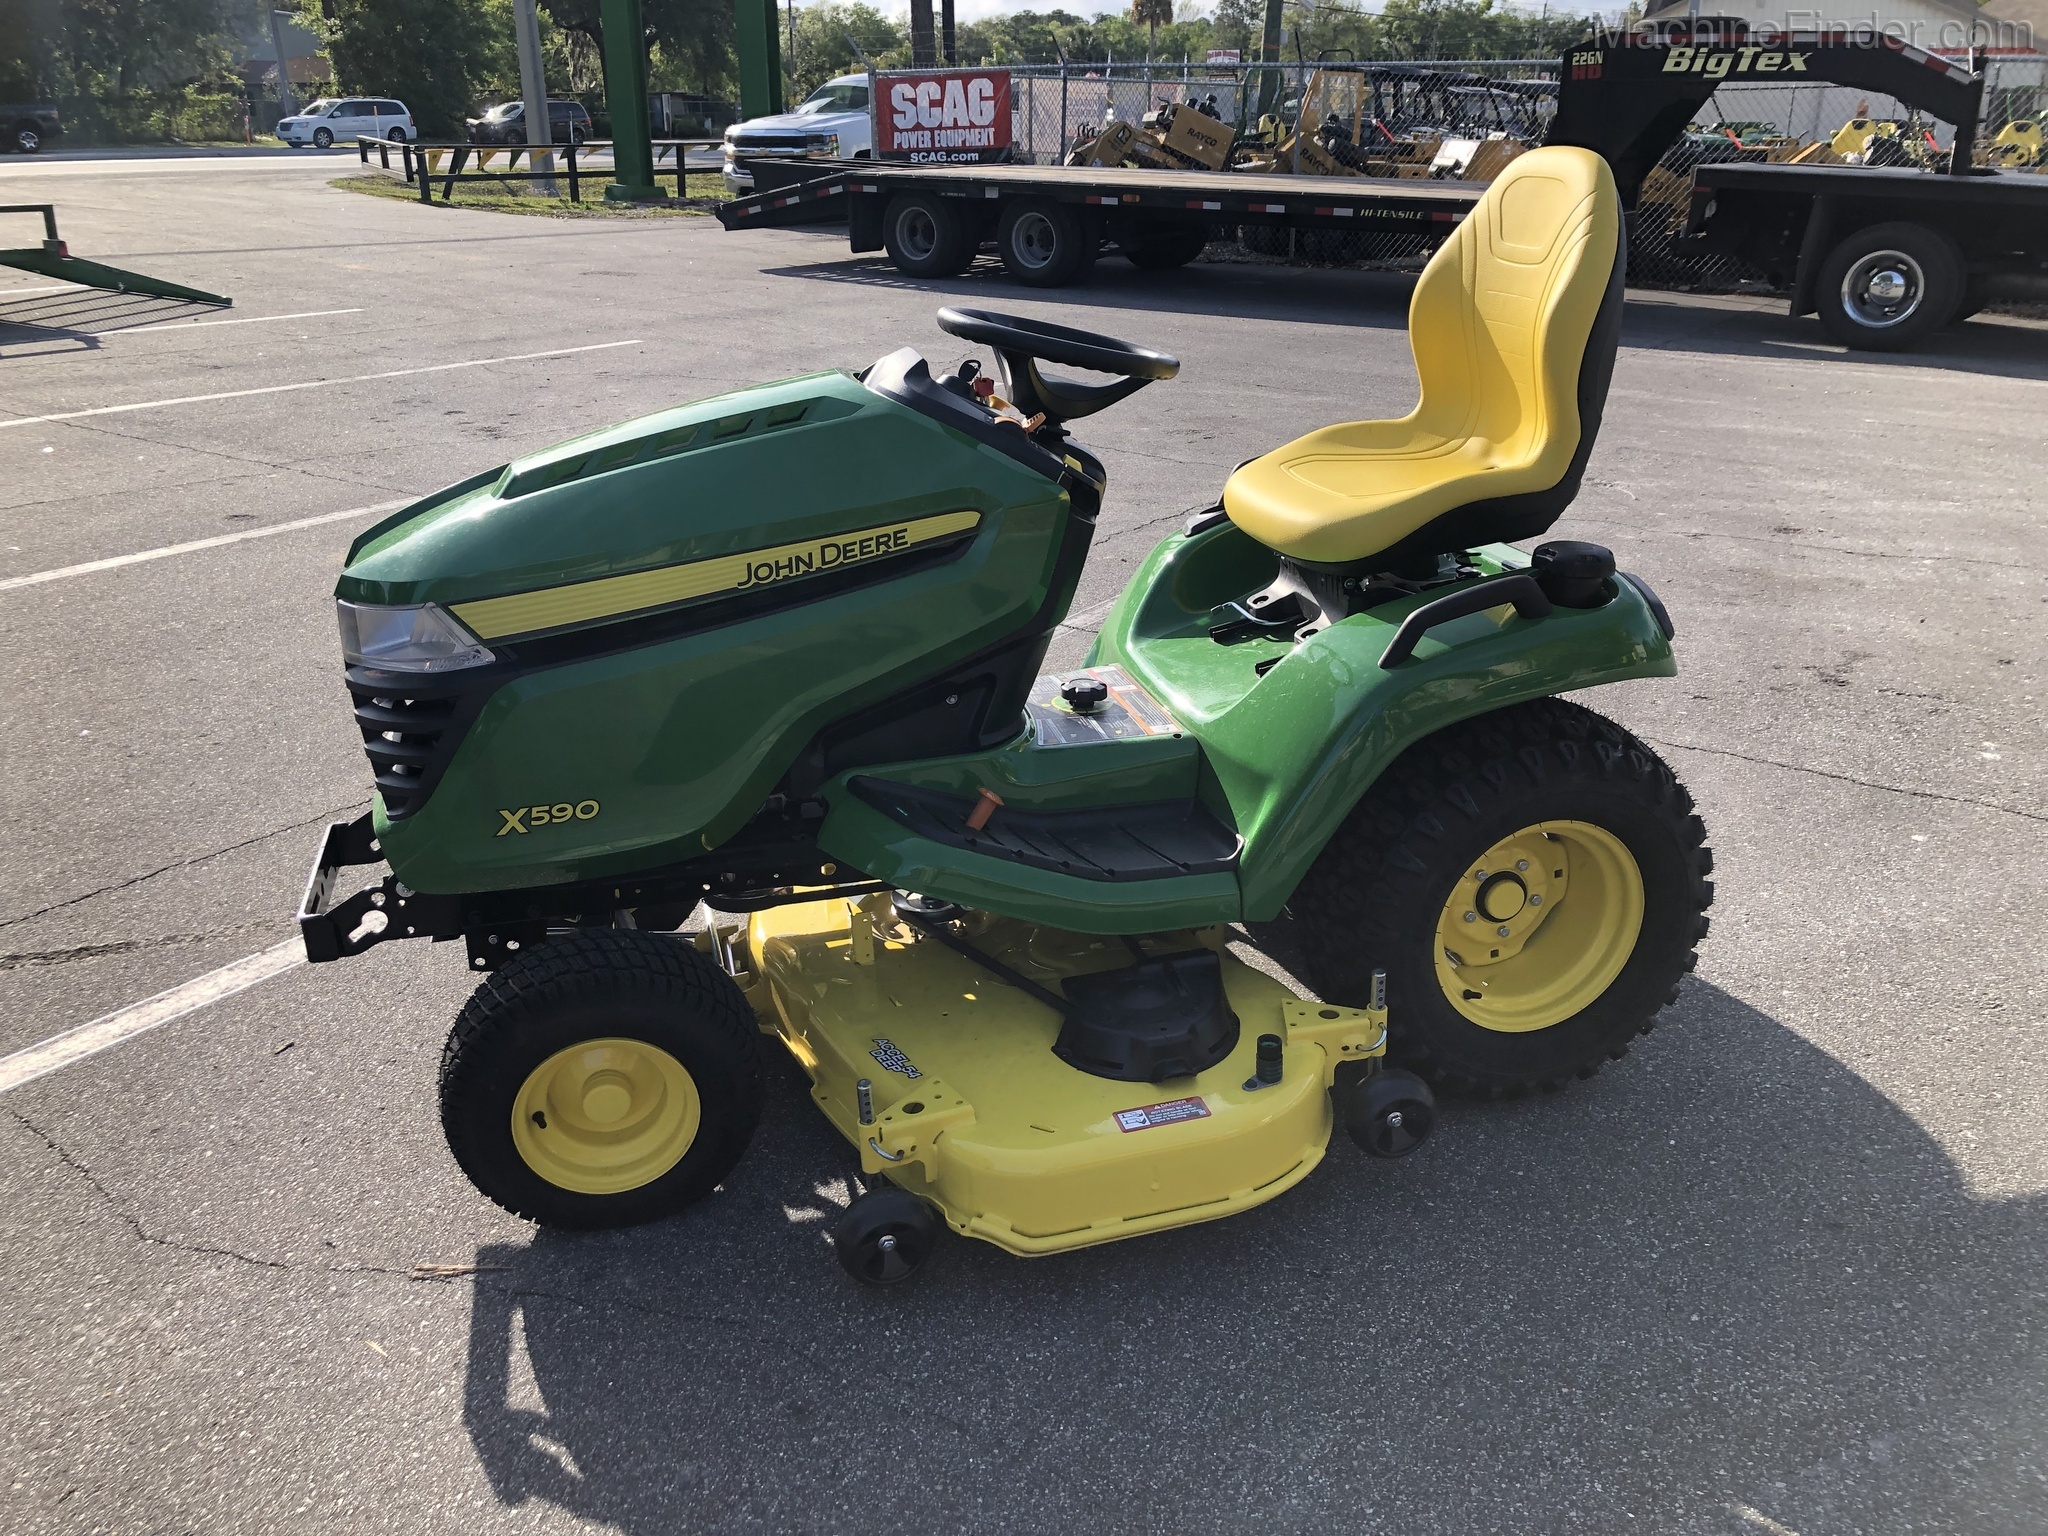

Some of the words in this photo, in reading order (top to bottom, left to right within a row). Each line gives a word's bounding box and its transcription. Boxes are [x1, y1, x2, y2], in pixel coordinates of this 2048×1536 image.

[1572, 51, 1604, 66] 22GN
[1662, 47, 1814, 79] BigTex
[1571, 65, 1603, 80] HD
[890, 77, 996, 130] SCAG
[893, 130, 932, 150] POWER
[934, 127, 996, 148] EQUIPMENT
[1186, 127, 1218, 147] RAYCO
[910, 152, 979, 163] SCAG.com
[1360, 208, 1425, 220] HI-TENSILE
[736, 551, 815, 589] JOHN
[820, 527, 911, 568] DEERE
[494, 798, 601, 837] X590
[869, 1049, 903, 1073] DEEP
[871, 1038, 911, 1067] ACCEL
[901, 1065, 923, 1079] 54
[1160, 1099, 1187, 1108] DANGER
